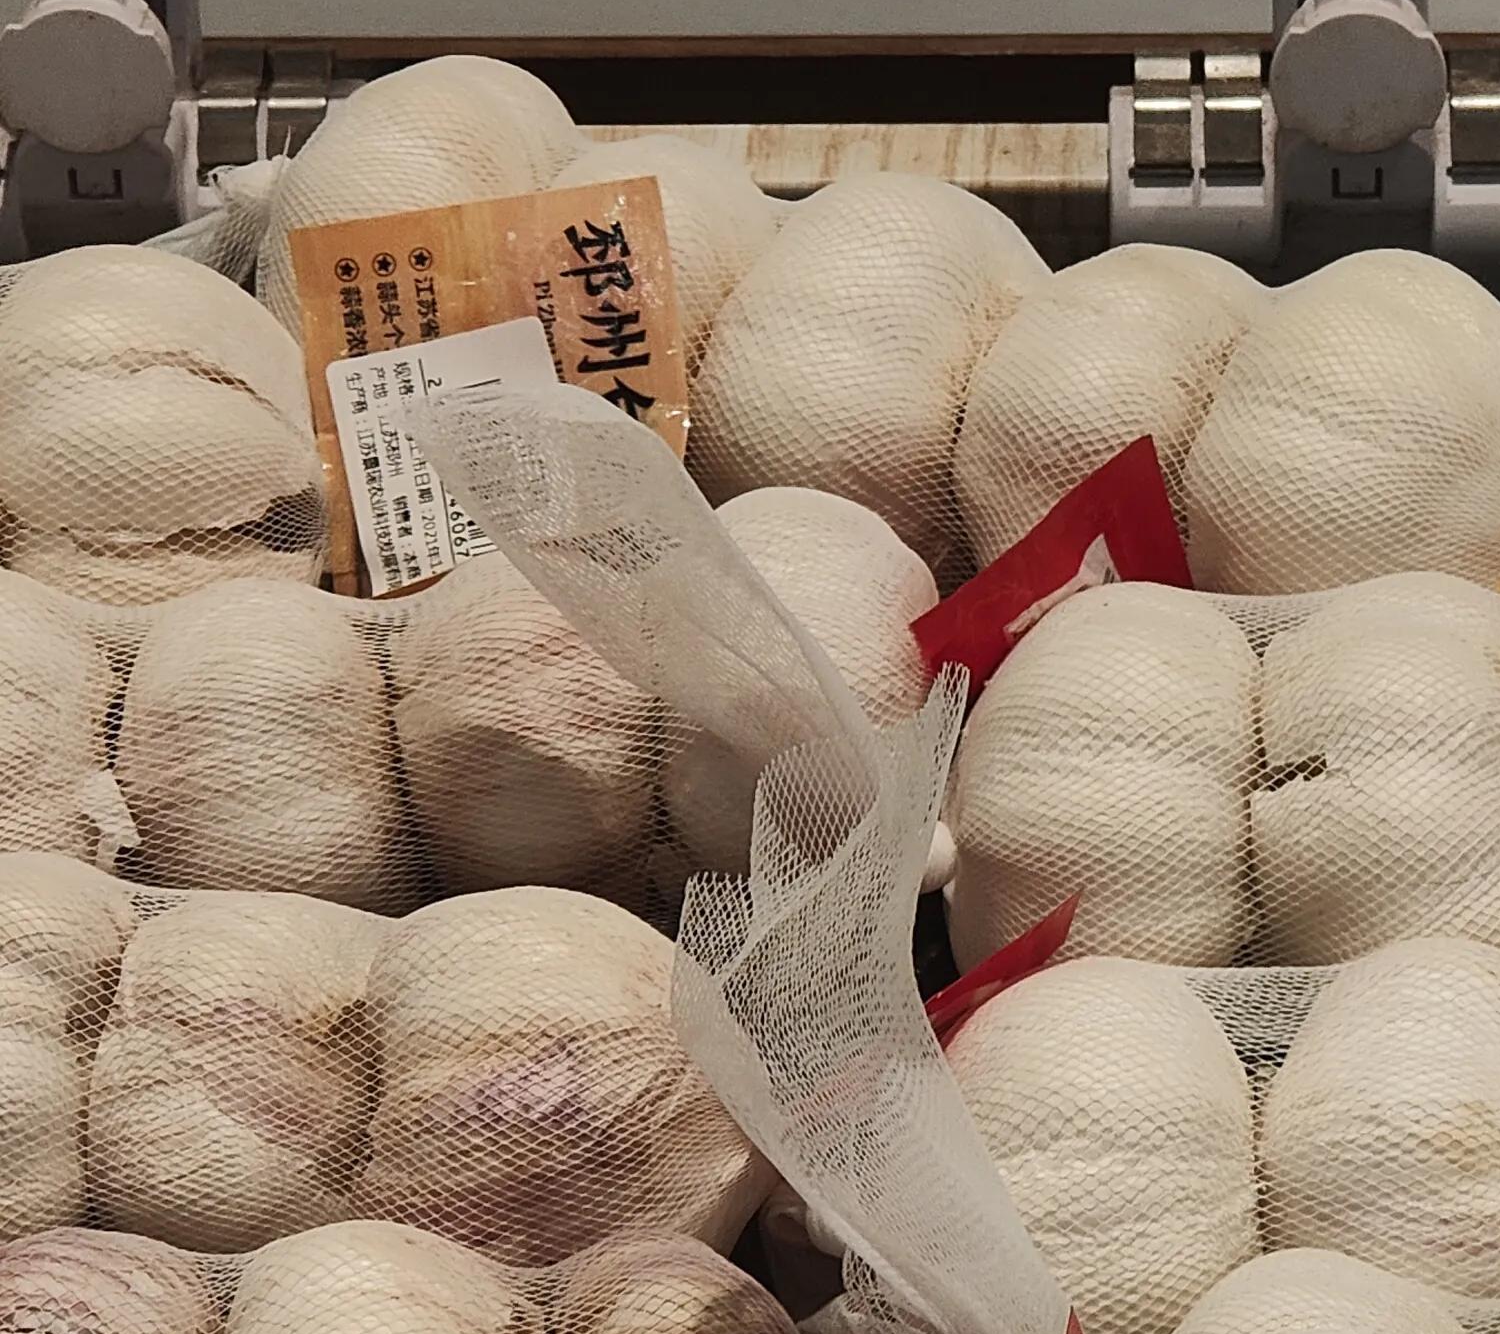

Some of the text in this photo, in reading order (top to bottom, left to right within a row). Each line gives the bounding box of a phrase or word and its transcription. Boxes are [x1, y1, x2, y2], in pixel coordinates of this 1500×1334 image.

[338, 285, 368, 357] 蒜香浓
[374, 281, 406, 352] 蒜头个
[414, 275, 441, 342] 江苏省
[533, 279, 551, 307] Pi
